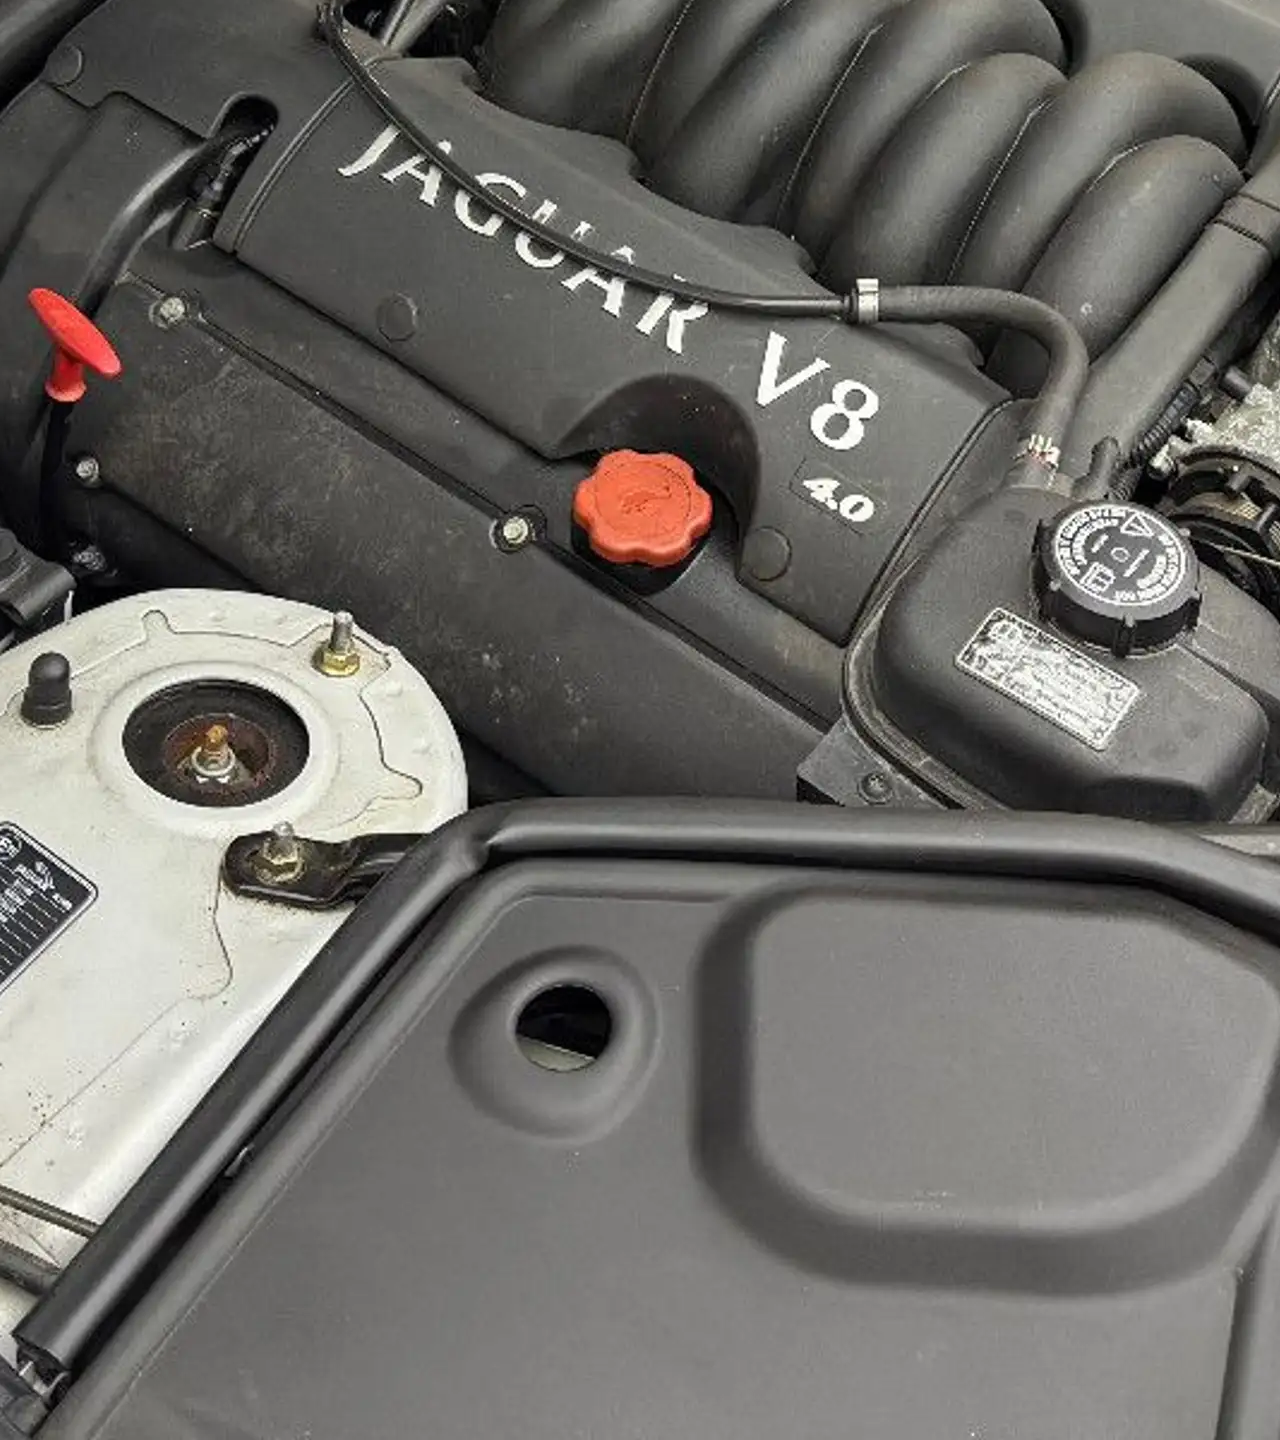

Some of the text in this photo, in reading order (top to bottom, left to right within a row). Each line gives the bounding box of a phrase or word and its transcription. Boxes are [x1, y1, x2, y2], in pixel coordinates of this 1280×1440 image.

[337, 122, 880, 451] JAGUAR V8
[802, 478, 875, 523] 4.0
